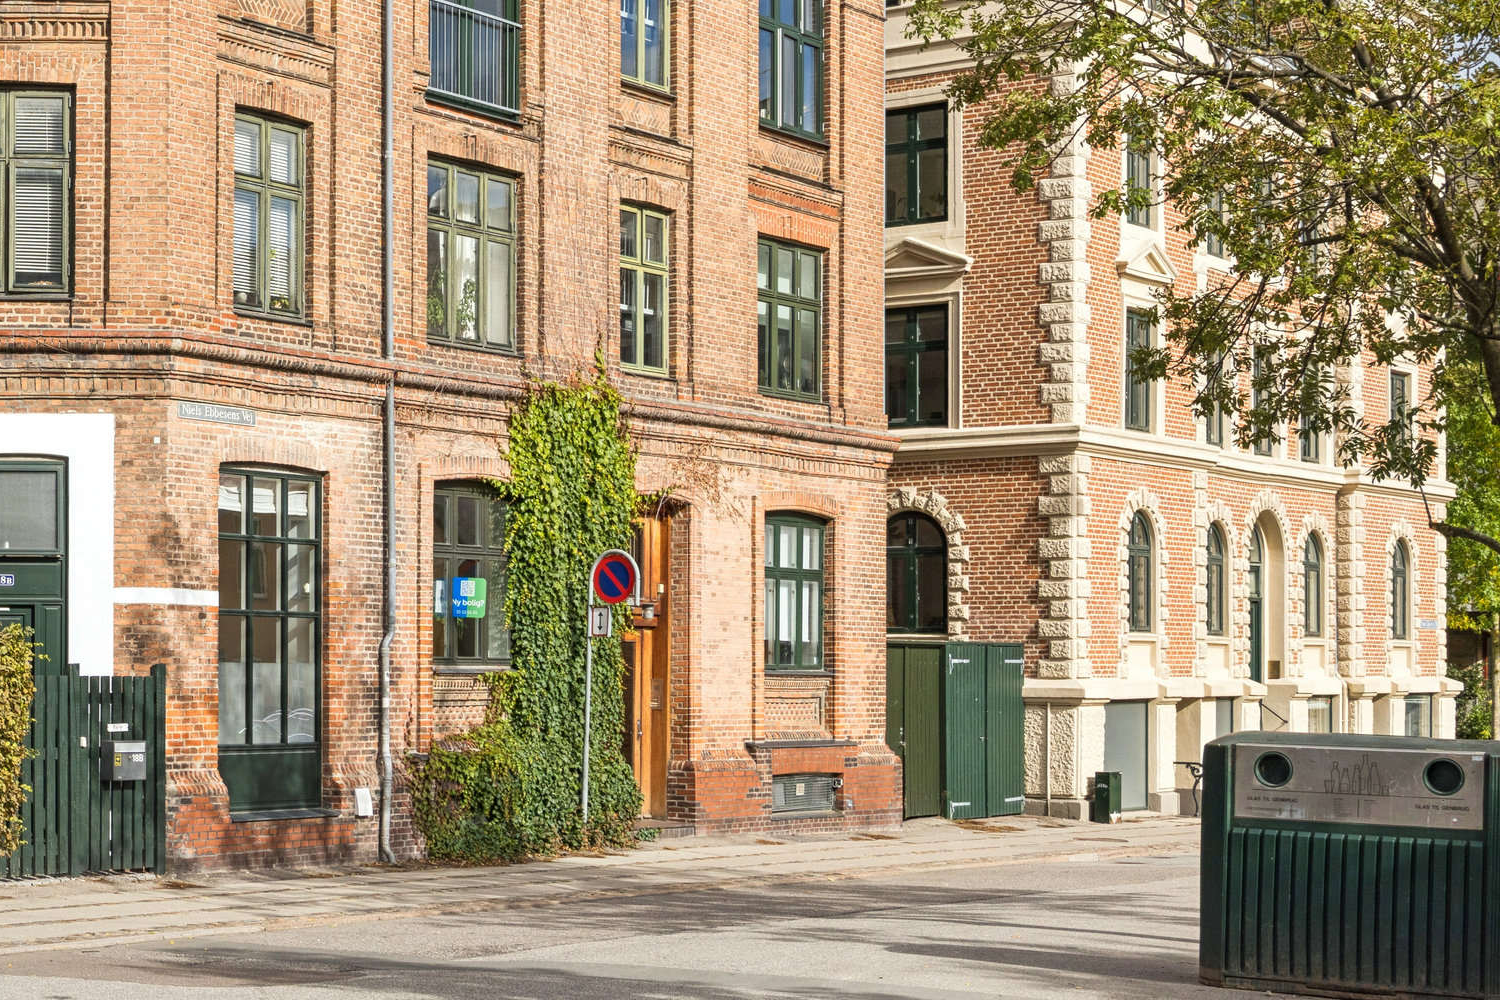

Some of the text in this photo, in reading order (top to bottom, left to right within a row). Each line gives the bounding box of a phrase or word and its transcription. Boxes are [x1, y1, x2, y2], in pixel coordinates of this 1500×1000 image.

[182, 404, 253, 424] Niels Ebbesens Vej
[462, 599, 485, 608] bolig?
[131, 753, 144, 763] 18B
